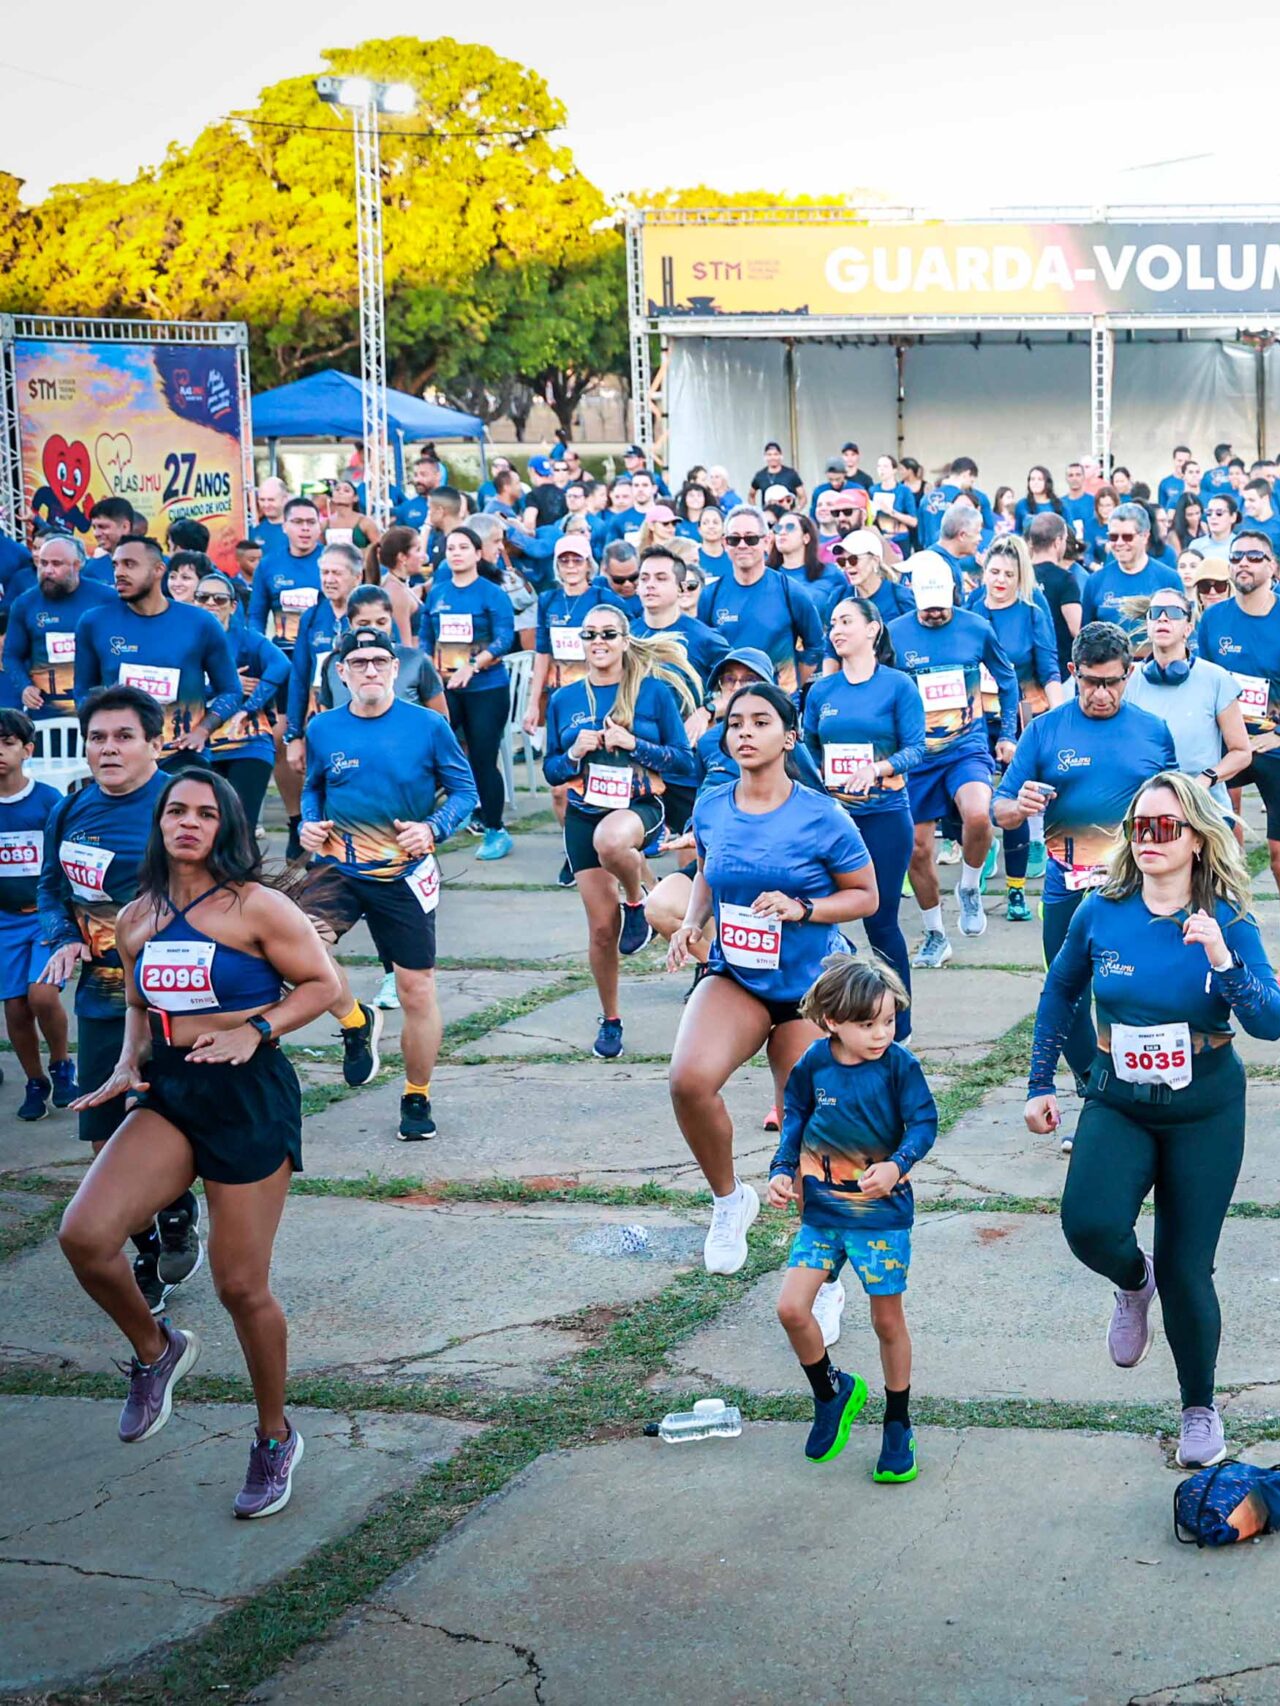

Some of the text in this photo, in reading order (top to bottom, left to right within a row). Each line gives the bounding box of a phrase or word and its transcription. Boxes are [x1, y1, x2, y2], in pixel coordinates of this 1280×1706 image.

[692, 261, 742, 281] STM
[28, 379, 58, 400] STM
[163, 453, 231, 504] 27 ANOS
[65, 864, 98, 887] 5116
[723, 926, 776, 950] 2095
[146, 968, 207, 989] 2096
[1124, 1050, 1186, 1070] 3035
